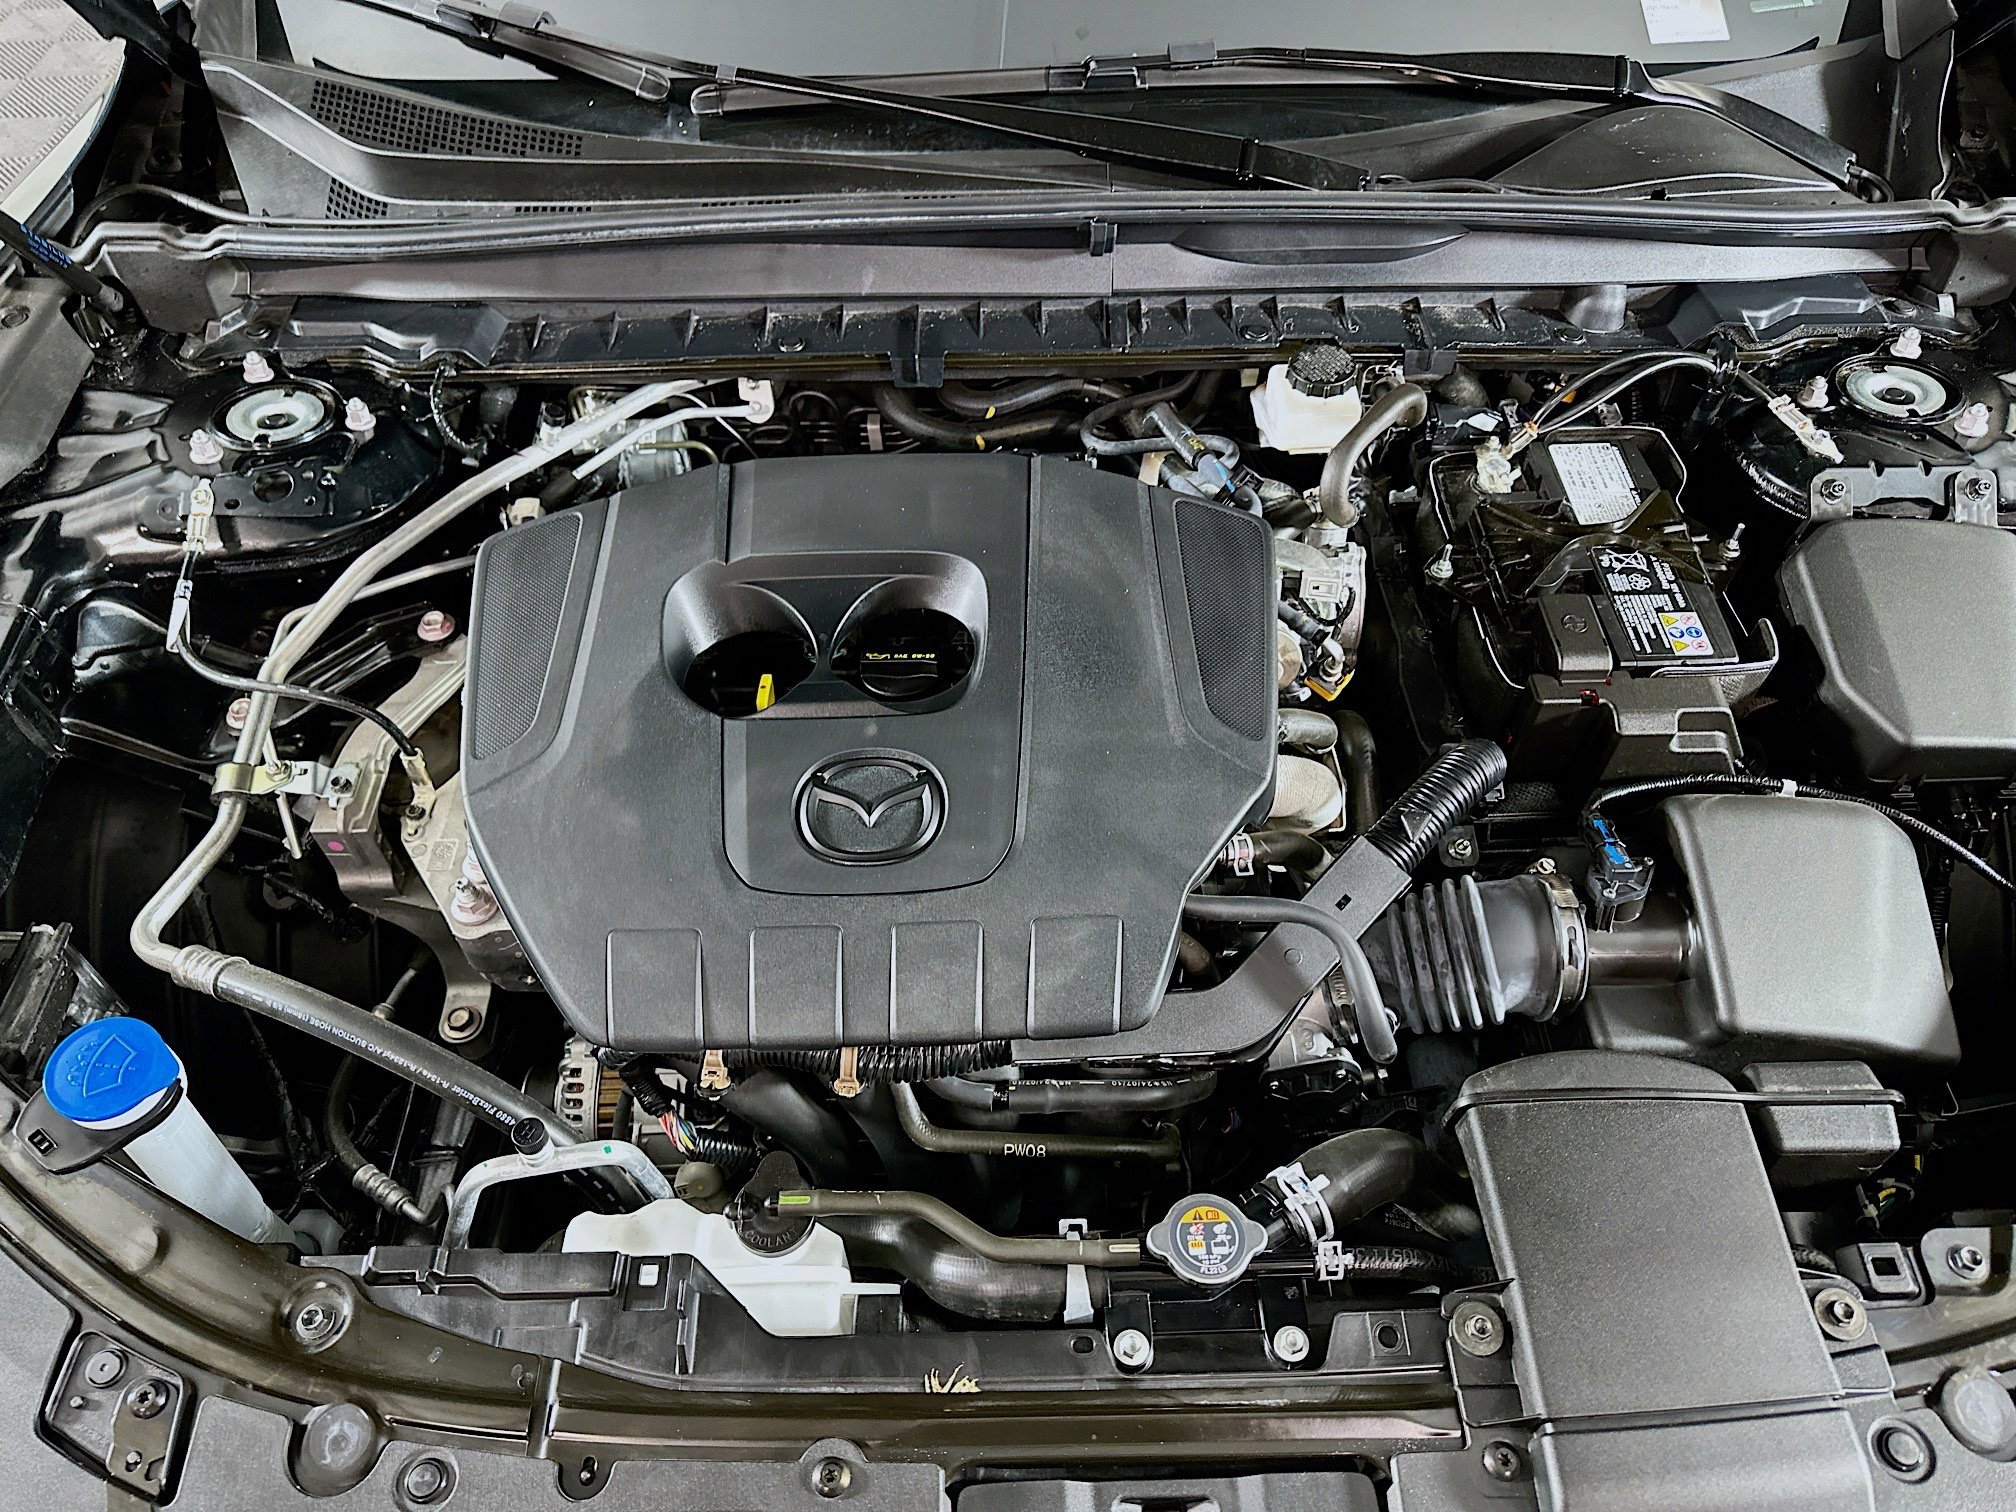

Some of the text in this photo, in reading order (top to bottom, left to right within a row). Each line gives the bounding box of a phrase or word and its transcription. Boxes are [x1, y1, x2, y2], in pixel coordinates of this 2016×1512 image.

[309, 1016, 332, 1032] HOSE
[331, 1026, 368, 1048] SUCTION
[367, 1044, 383, 1055] A/C
[381, 1051, 417, 1072] R-1234yf
[422, 1070, 450, 1089] R-134a
[451, 1084, 498, 1116] FlexBarrier
[495, 1111, 517, 1126] 4880
[1004, 1143, 1047, 1158] PW08
[743, 1226, 801, 1249] COOLANT
[1199, 1265, 1219, 1275] FL22
